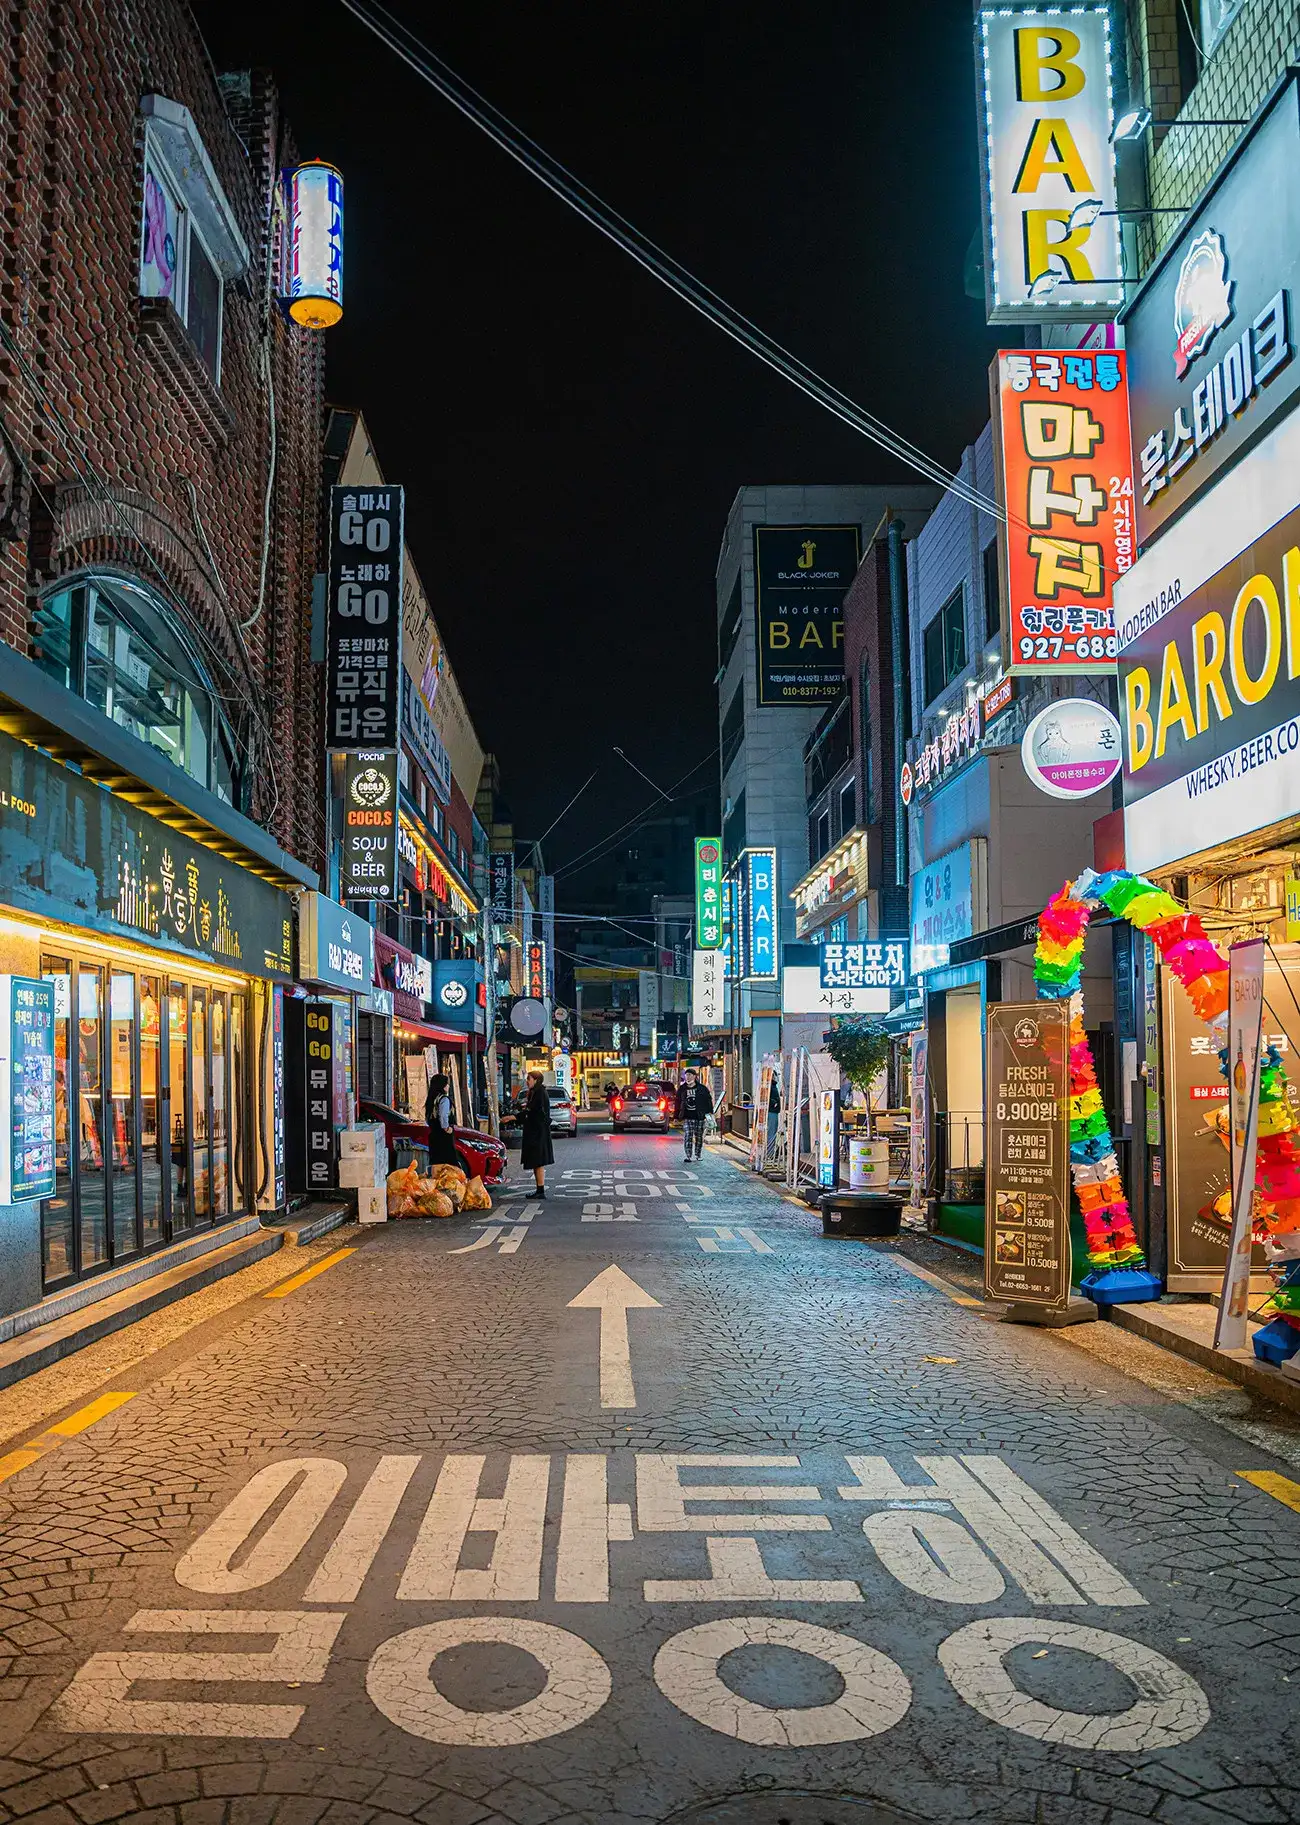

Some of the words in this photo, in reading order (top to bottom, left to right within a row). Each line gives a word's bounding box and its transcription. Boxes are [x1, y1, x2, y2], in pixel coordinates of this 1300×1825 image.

[1012, 26, 1097, 285] BAR
[342, 494, 390, 511] 술마시
[1021, 402, 1106, 598] 마사지
[339, 511, 391, 552] GO
[340, 564, 391, 582] 노래하
[337, 583, 389, 625] GO
[778, 605, 839, 615] Modern
[1116, 595, 1160, 650] MODERN
[1160, 578, 1182, 612] BAR
[338, 638, 389, 652] 포장마차
[337, 655, 388, 669] 가격으로
[335, 671, 387, 702] 뮤직
[335, 707, 387, 739] 타운
[358, 752, 385, 761] Pocha
[11, 795, 36, 818] FOOD
[352, 836, 387, 851] SOJU
[365, 852, 373, 862] &
[352, 863, 385, 877] BEER
[702, 868, 718, 942] 리춘시장
[755, 873, 770, 955] BAR
[824, 943, 905, 971] 퓨전포차
[823, 969, 905, 987] 수라간이야기
[307, 1012, 329, 1032] GO
[309, 1040, 331, 1060] GO
[1006, 1066, 1048, 1080] FRESH
[999, 1083, 1055, 1098] 등심스테이크
[997, 1102, 1058, 1121] 8,900원!
[309, 1069, 331, 1182] 뮤직타운
[1000, 1167, 1009, 1175] AM
